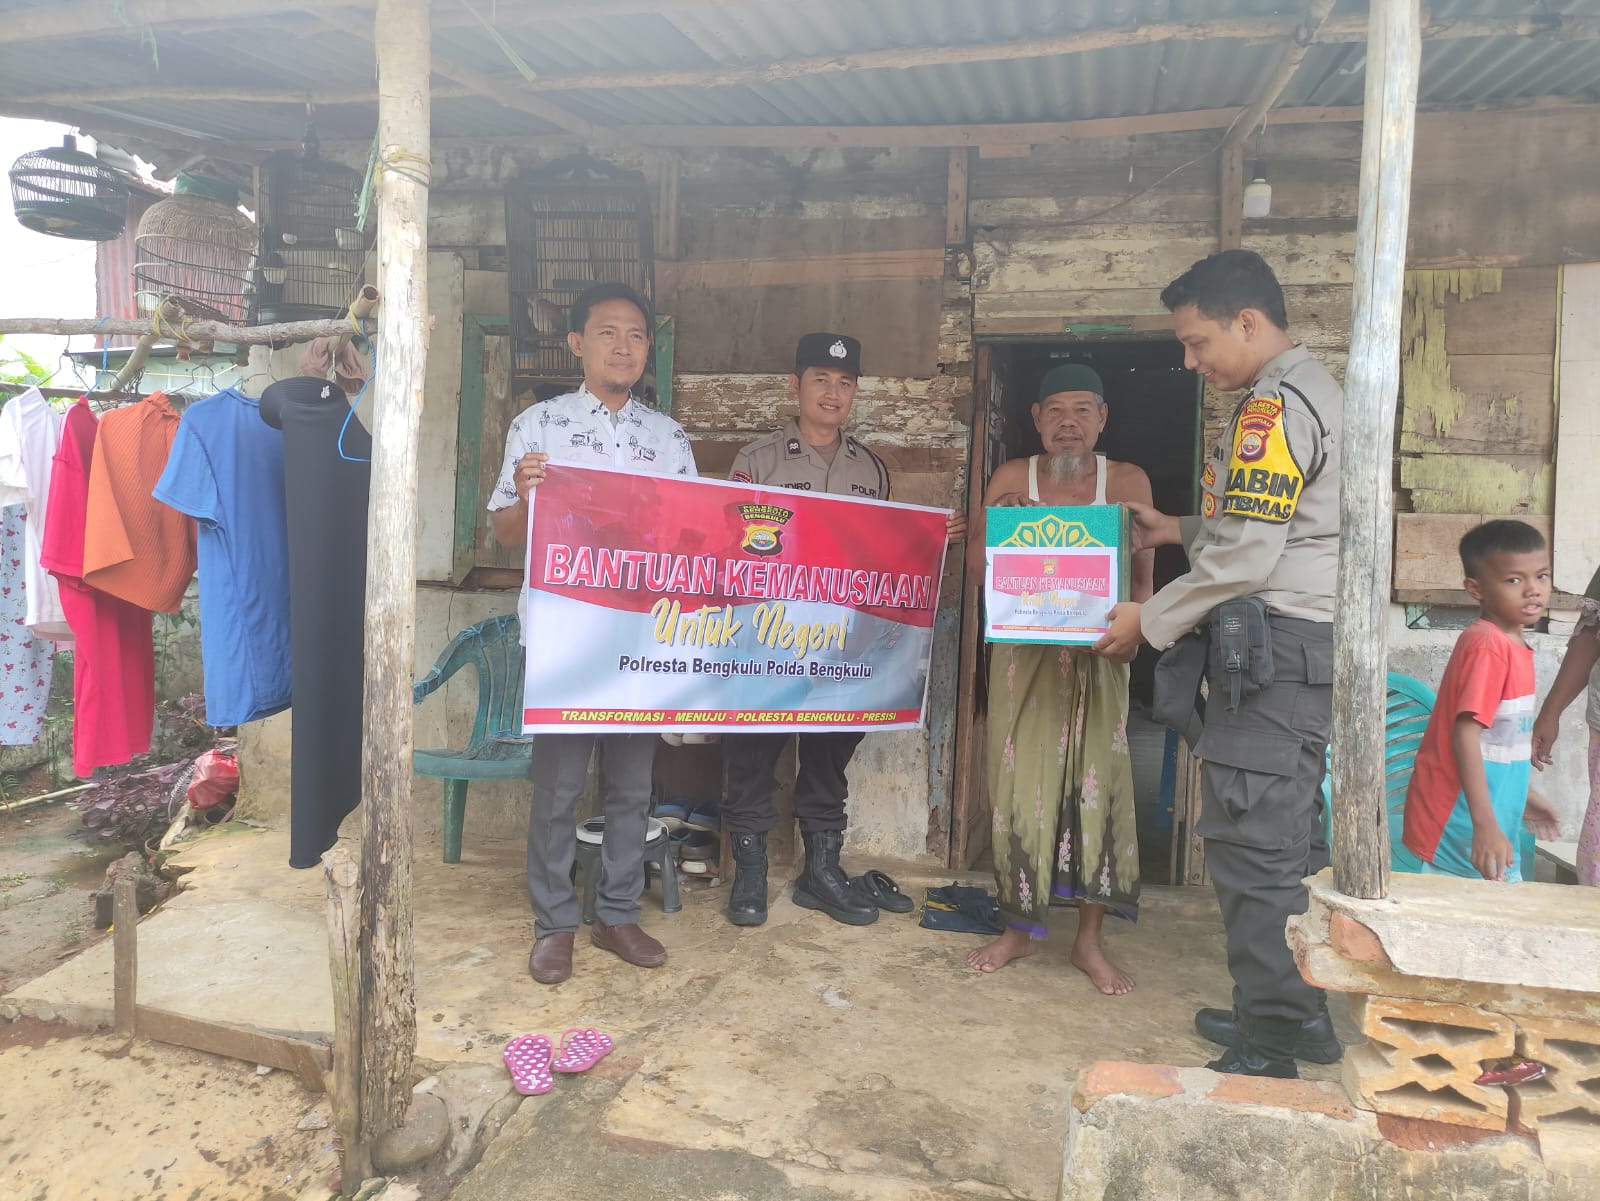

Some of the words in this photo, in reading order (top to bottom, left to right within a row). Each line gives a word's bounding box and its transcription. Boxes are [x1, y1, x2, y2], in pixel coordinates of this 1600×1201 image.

[544, 543, 716, 595] BANTUAN
[724, 559, 931, 609] KEMANUSIAAN
[651, 597, 742, 649] Untuk
[752, 602, 848, 660] Negeri
[618, 655, 687, 674] Polresta
[692, 657, 762, 679] Bengkulu
[766, 660, 805, 676] Polda
[809, 661, 873, 681] Bengkulu
[561, 711, 665, 722] TRANSFORMASI
[674, 712, 727, 722] MENUJU
[735, 712, 793, 722] POLRESTA
[796, 712, 855, 722] BENGKULU
[861, 711, 897, 722] PRESISI
